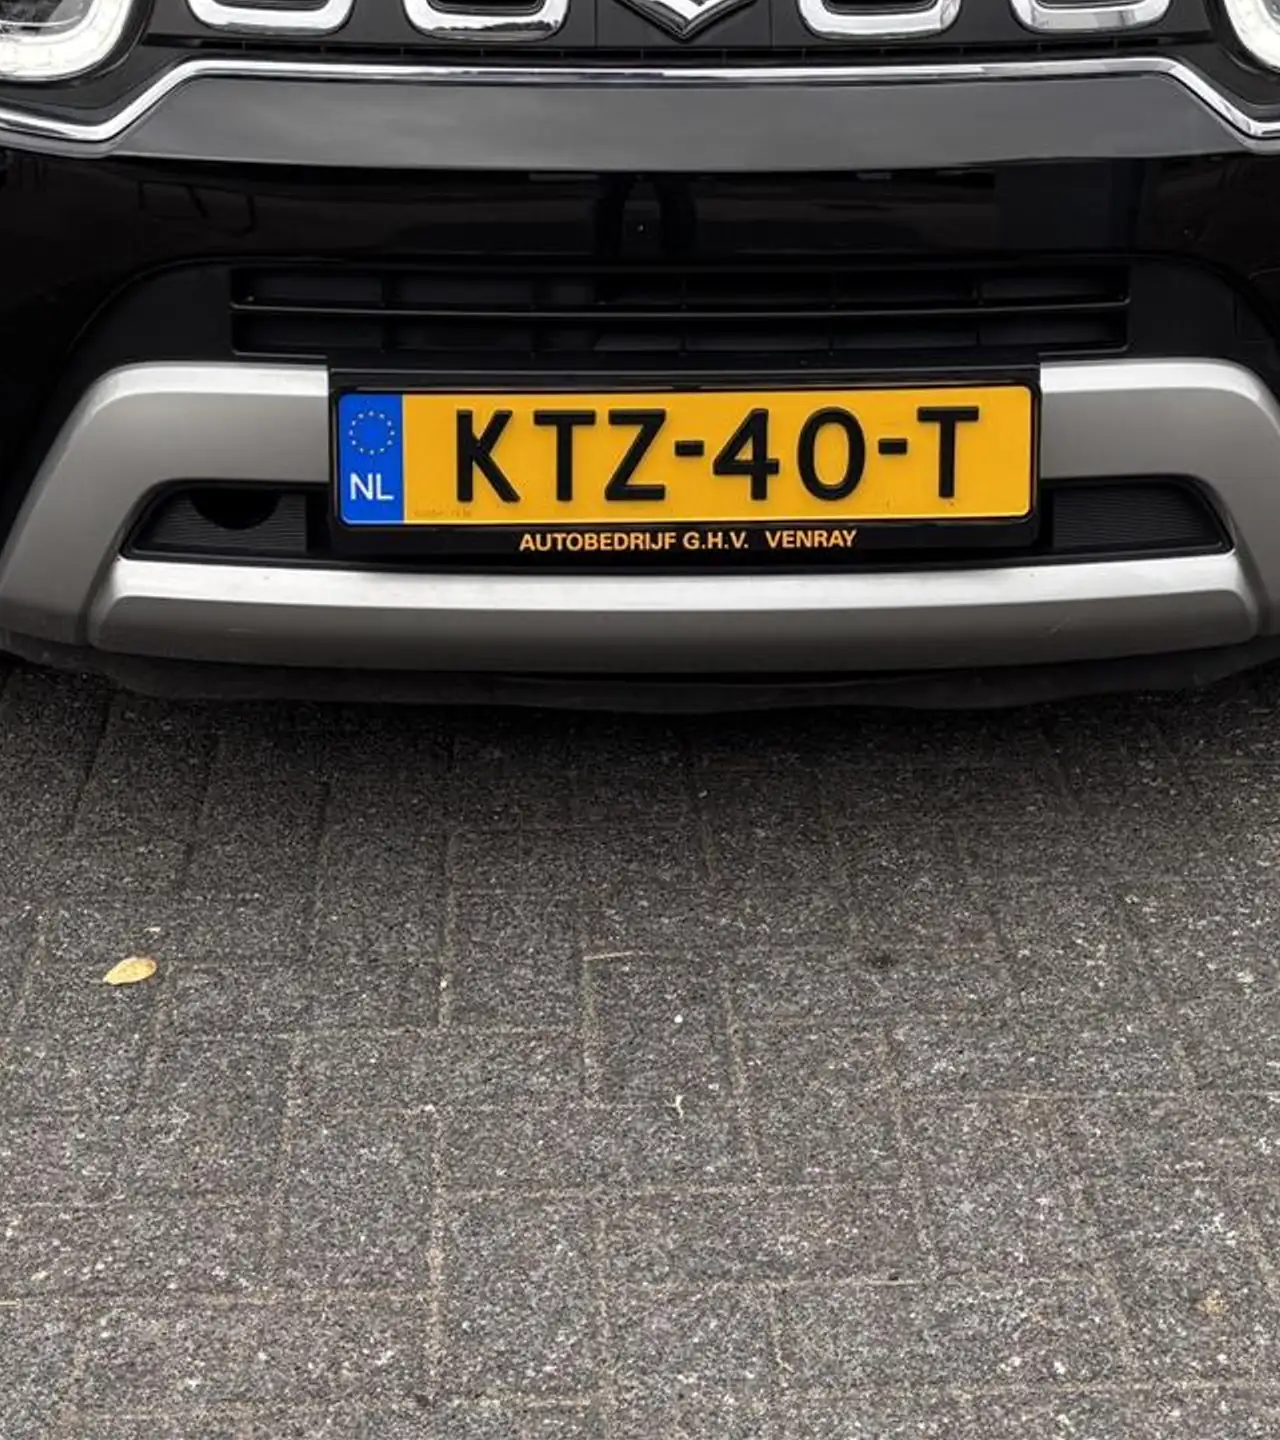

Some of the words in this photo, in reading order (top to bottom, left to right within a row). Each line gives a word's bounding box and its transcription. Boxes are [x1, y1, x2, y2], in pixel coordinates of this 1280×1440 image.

[453, 405, 981, 503] KTZ-40-T
[349, 472, 394, 502] NL
[518, 531, 677, 553] AUTOBEDRIJF
[683, 531, 750, 551] G.H.V.
[765, 529, 858, 550] VENRAY
